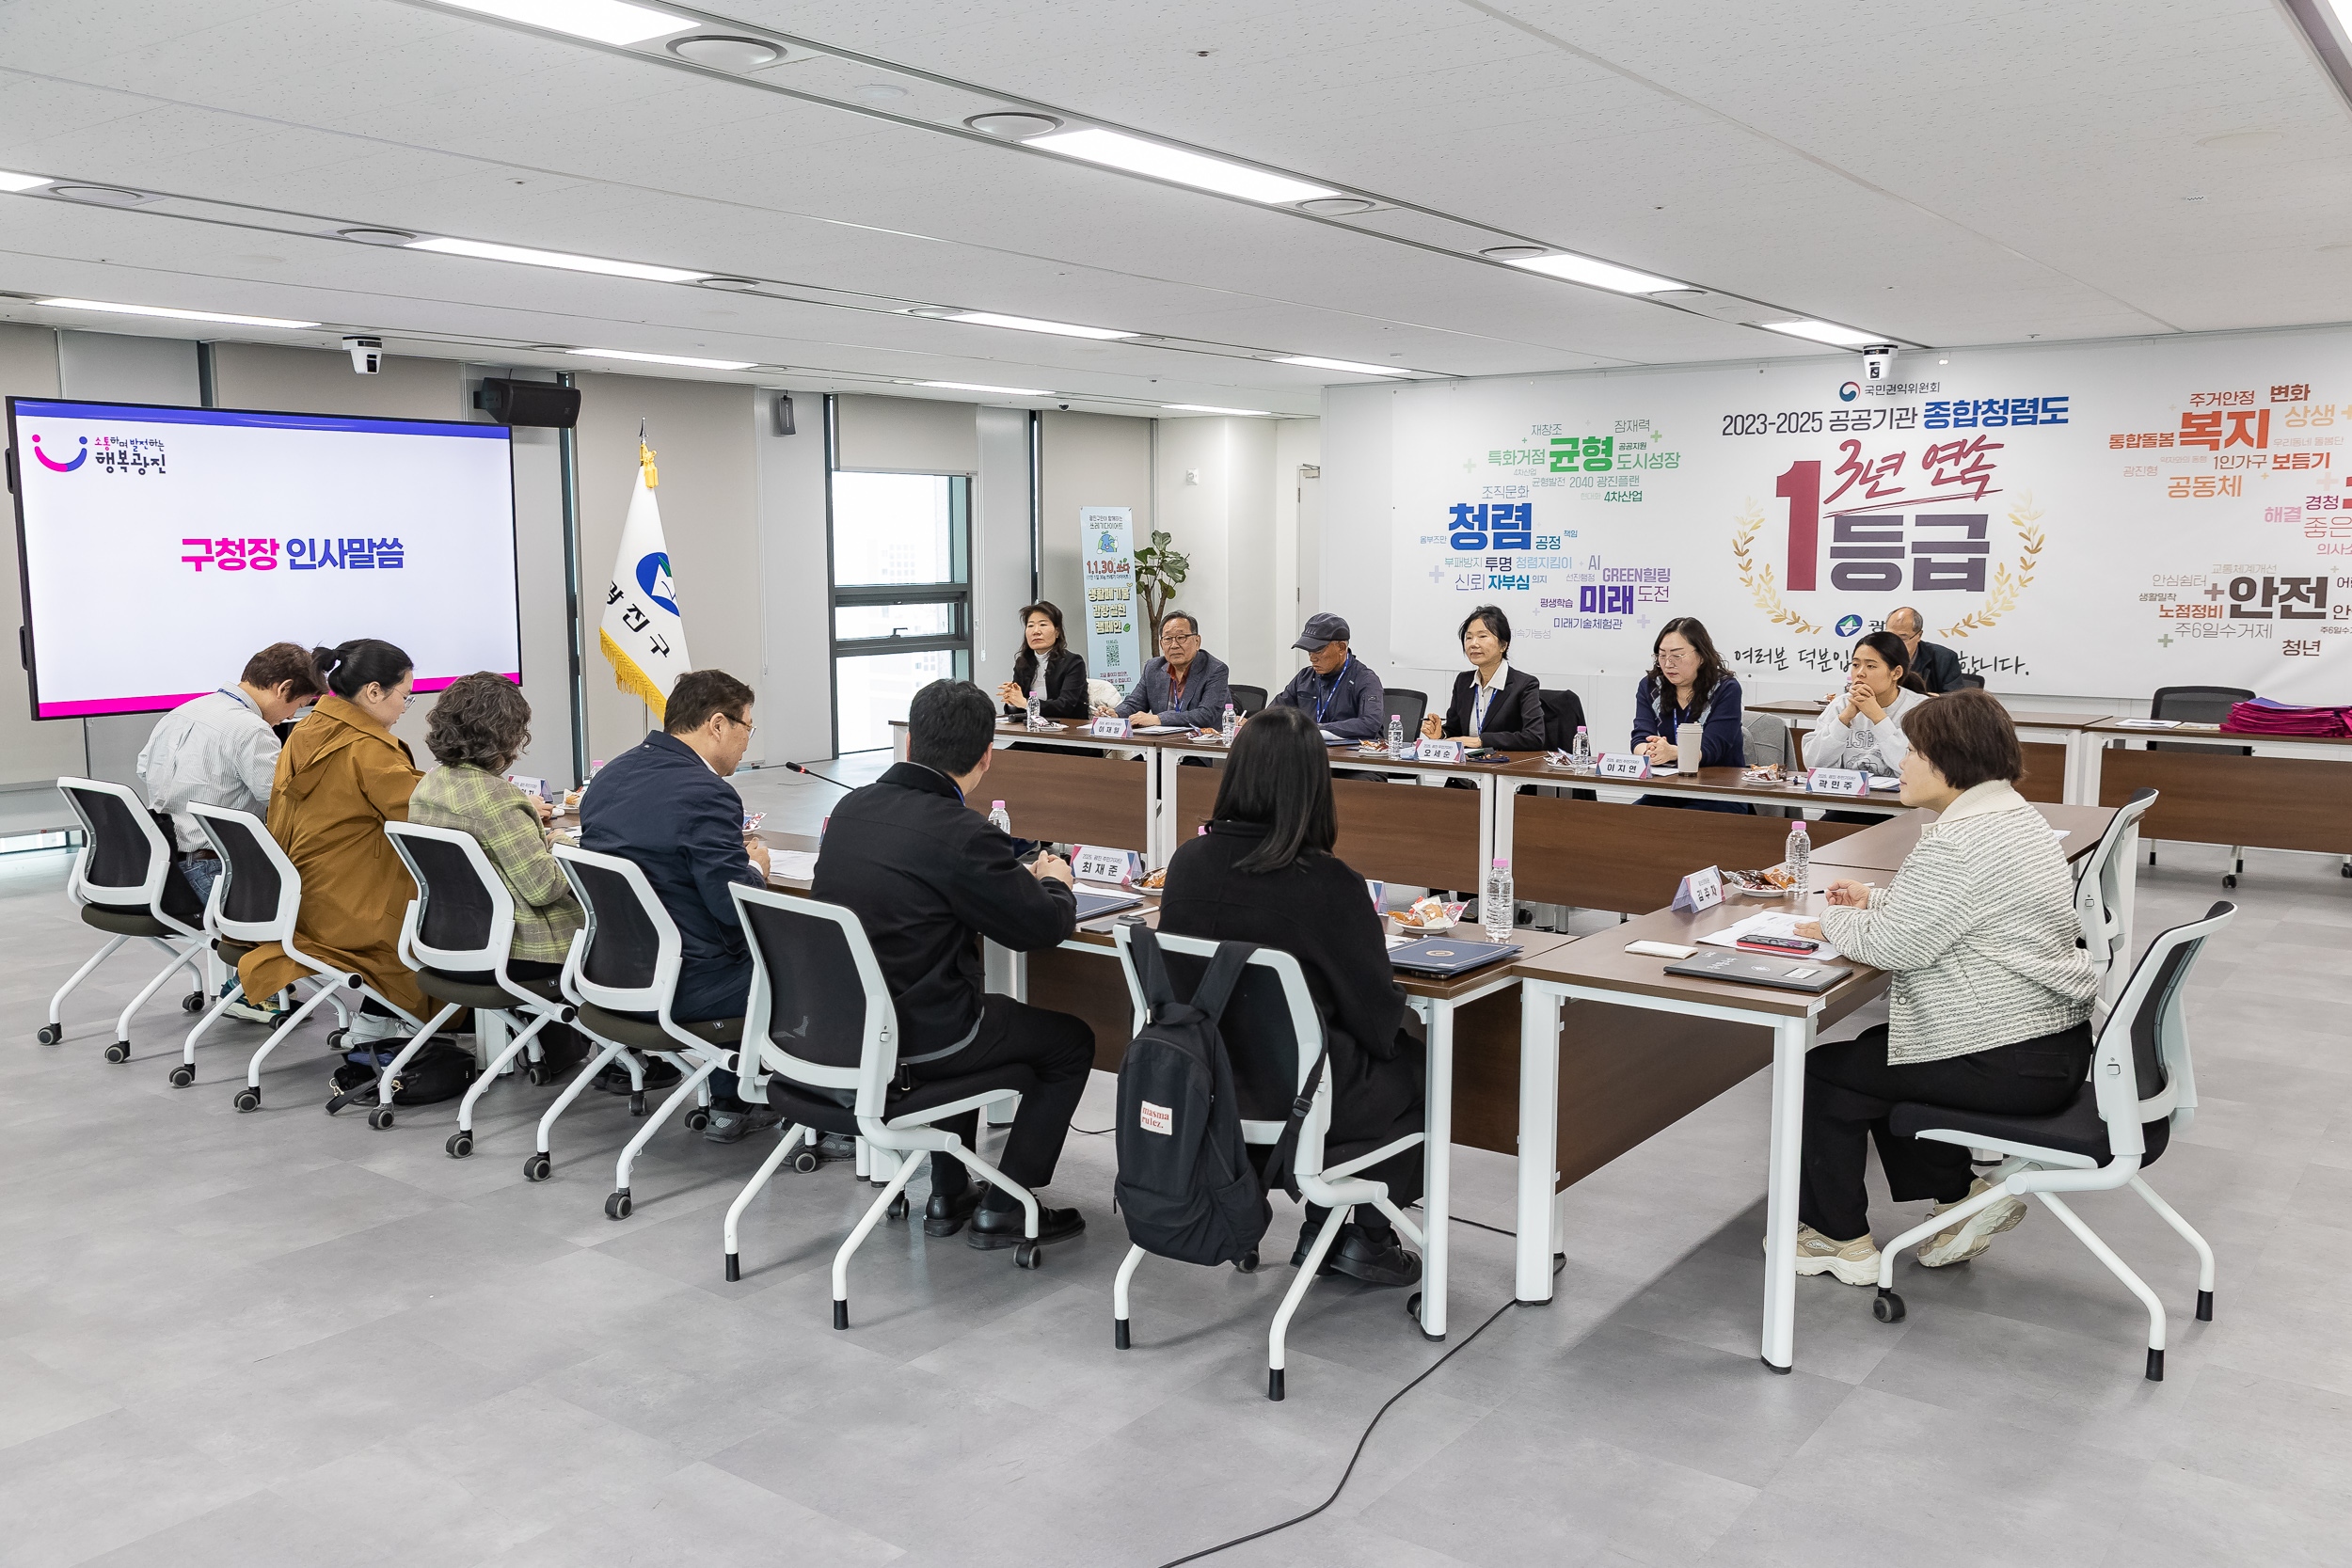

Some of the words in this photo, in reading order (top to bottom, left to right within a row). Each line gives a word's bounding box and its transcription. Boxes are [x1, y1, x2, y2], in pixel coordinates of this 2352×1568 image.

[1864, 381, 1941, 396] 국민권익위원회
[2269, 384, 2311, 404] 변화
[2188, 390, 2255, 407] 주거안정
[1722, 411, 1823, 436] 2023-2025
[1829, 407, 1918, 433] 공공기관
[1922, 396, 2070, 430] 종합청렴도
[2284, 404, 2335, 428] 상생
[1531, 423, 1563, 436] 재창조
[1613, 419, 1650, 433] 잠재력
[2178, 408, 2271, 451] 복지
[94, 436, 128, 451] 소통하며
[129, 437, 165, 452] 발전하는
[1617, 441, 1647, 451] 공공지원
[2109, 432, 2175, 450] 통합돌봄
[1487, 449, 1546, 467] 특화거점
[1549, 436, 1614, 472] 균형
[1616, 451, 1681, 470] 도시성장
[2213, 453, 2268, 470] 1인가구
[2271, 451, 2331, 470] 보듬기
[95, 450, 167, 476] 행복광진
[1822, 438, 1907, 505] 3년
[1921, 434, 2005, 503] 연속
[2122, 465, 2158, 478] 광진형
[1532, 477, 1565, 487] 균형발전
[1568, 476, 1594, 488] 2040
[1597, 475, 1640, 488] 광진플랜
[2168, 475, 2243, 499] 공동체
[1482, 484, 1530, 499] 조직문화
[1603, 490, 1643, 503] 4차산업
[2305, 496, 2339, 511] 경청
[2264, 506, 2302, 523] 해결
[1448, 502, 1533, 551] 청렴
[1564, 529, 1579, 538] 책임
[2303, 516, 2352, 538] 좋은
[1535, 535, 1561, 550] 공정
[181, 537, 280, 572] 구청장
[286, 537, 405, 570] 인사말씀
[1444, 557, 1483, 569] 부패방지
[1485, 556, 1512, 572] 투명
[1516, 556, 1573, 570] 청렴지킴이
[1588, 555, 1601, 571] AI
[2211, 563, 2277, 575] 교통체계개선
[1454, 573, 1486, 591] 신뢰
[1532, 574, 1548, 584] 의지
[1565, 573, 1596, 582] 선진행정
[1602, 567, 1671, 583] GREEN힐링
[2152, 574, 2207, 587] 안심쉼터
[1487, 574, 1531, 592] 자부심
[2336, 577, 2352, 589] 어
[1088, 587, 1131, 602] 생활폐기물
[1580, 584, 1634, 615] 미래
[1637, 585, 1669, 603] 도전
[2229, 577, 2328, 620] 안전
[1540, 598, 1574, 609] 평생학습
[2159, 604, 2223, 619] 노점정비
[1095, 620, 1122, 635] 캠페인
[1553, 618, 1623, 629] 미래기술체험관
[2174, 622, 2273, 639] 주6일수거제
[2320, 626, 2352, 635] 주6일수
[2281, 640, 2321, 657] 청년
[1734, 646, 1789, 672] 여러분
[1607, 763, 1637, 774] 이지연
[1819, 779, 1852, 790] 곽민주
[1082, 862, 1118, 877] 최재준
[1142, 1107, 1169, 1120] masma
[1141, 1116, 1164, 1129] rulez.
